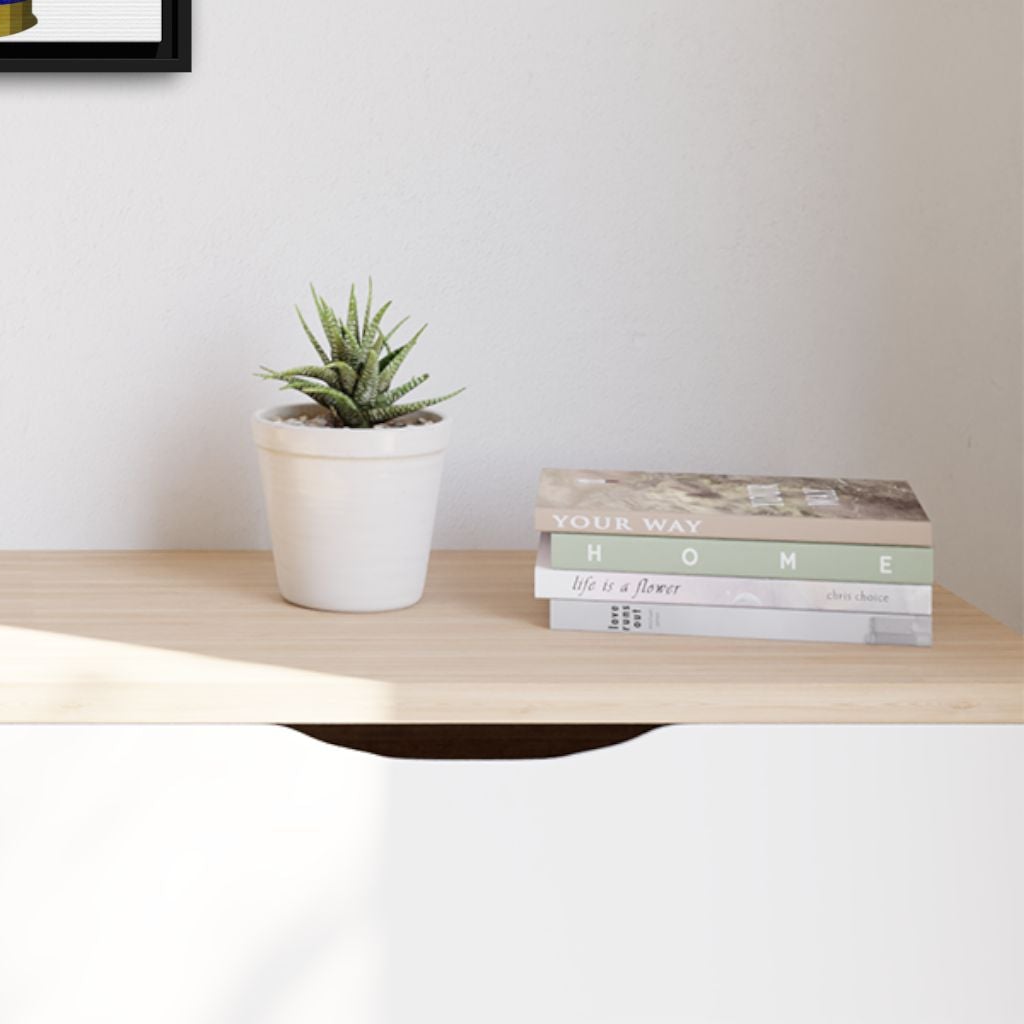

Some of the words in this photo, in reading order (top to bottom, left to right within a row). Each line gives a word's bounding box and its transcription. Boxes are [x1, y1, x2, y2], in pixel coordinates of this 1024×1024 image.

[553, 514, 632, 531] YOUR
[643, 517, 703, 534] WAY
[571, 575, 597, 596] life
[602, 579, 616, 592] is
[620, 583, 628, 593] a
[632, 577, 682, 599] flower
[826, 589, 852, 601] chris
[608, 605, 619, 630] love
